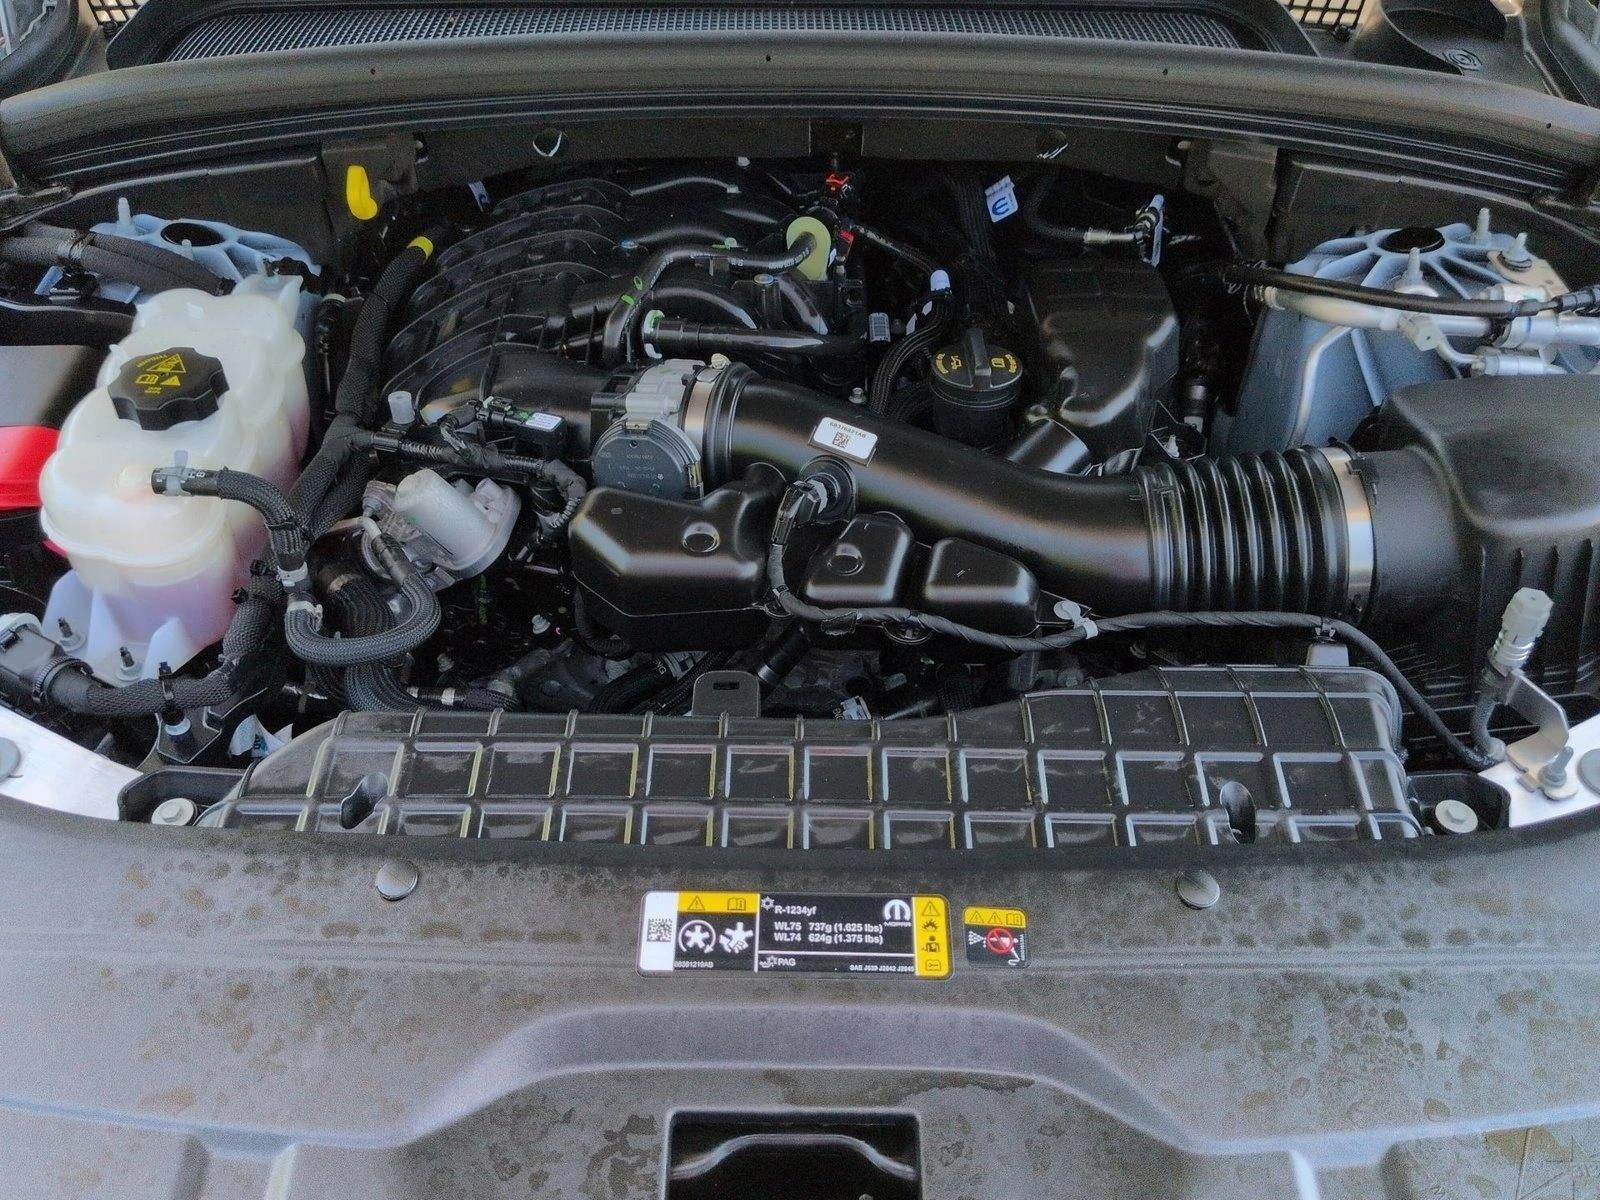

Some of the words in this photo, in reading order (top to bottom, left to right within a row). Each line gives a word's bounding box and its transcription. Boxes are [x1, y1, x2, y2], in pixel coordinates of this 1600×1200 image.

[774, 905, 817, 917] R-1234yf
[774, 921, 802, 932] WL75
[808, 922, 832, 934] 737g
[833, 922, 863, 934] (1.625
[864, 922, 883, 934] lbs)
[774, 932, 802, 942] WL74
[808, 933, 832, 944] 624g
[833, 933, 863, 945] (1.375
[864, 934, 883, 945] lbs)
[777, 958, 796, 967] PAG
